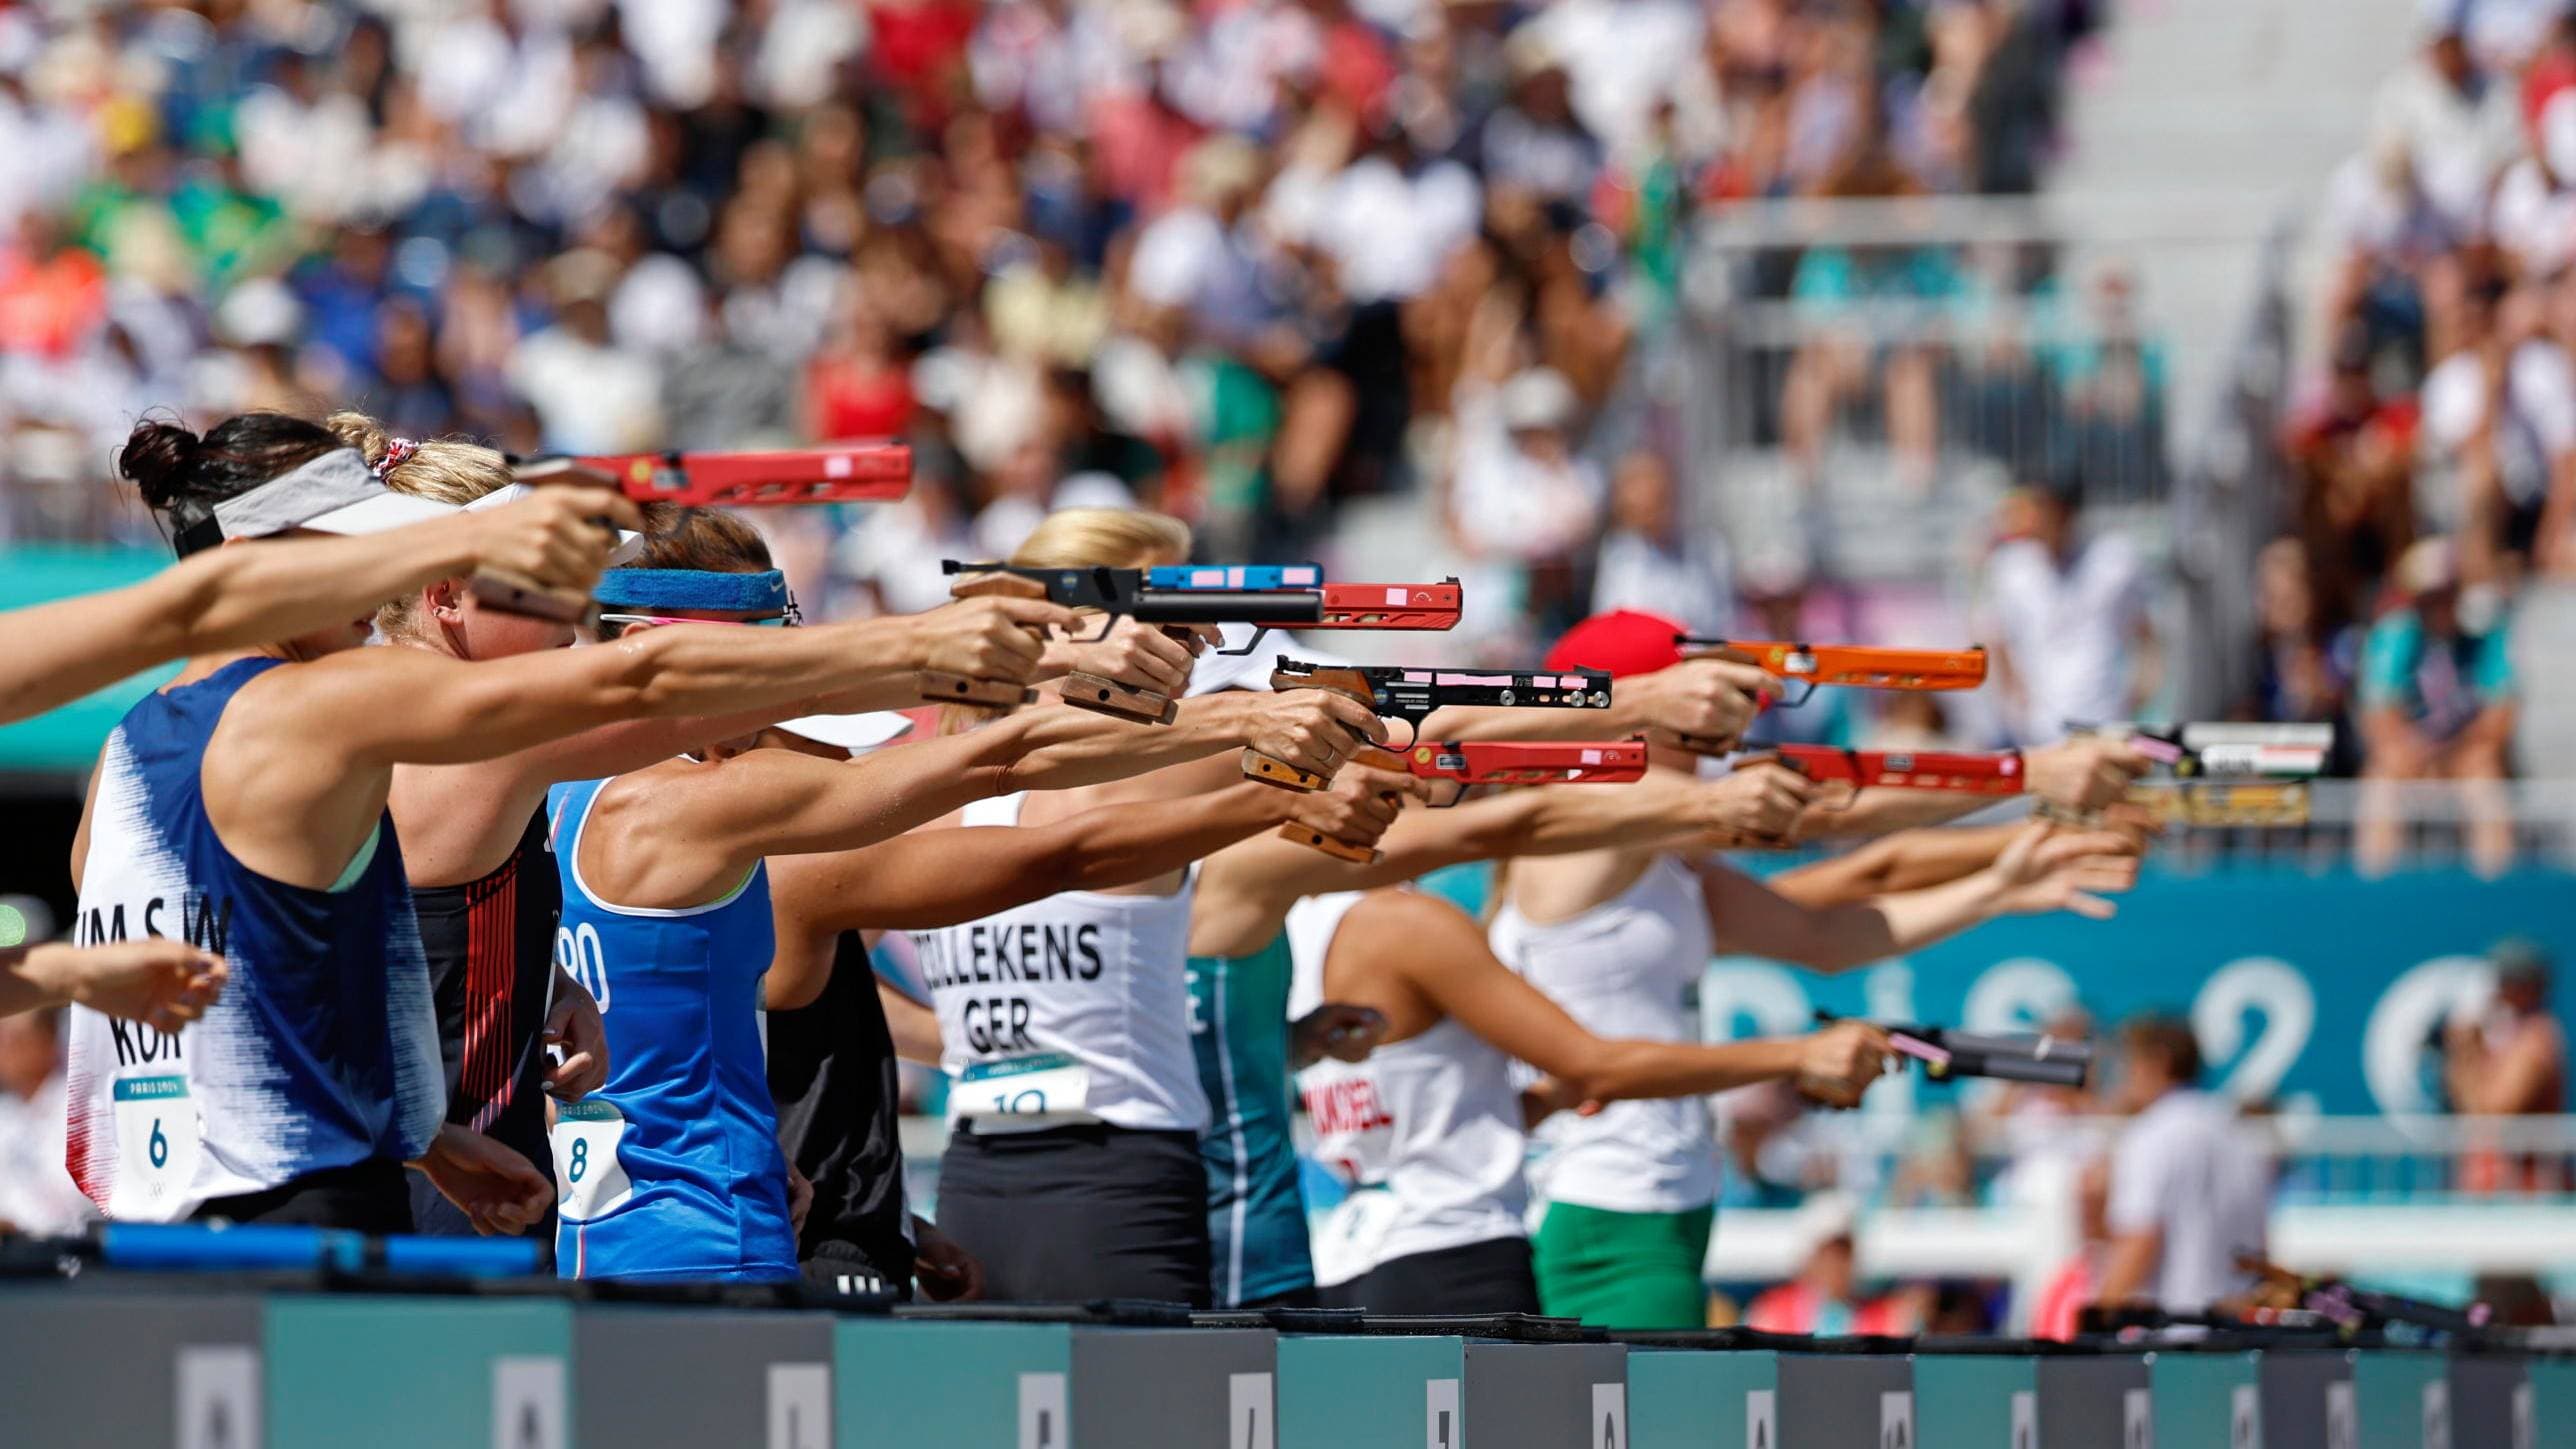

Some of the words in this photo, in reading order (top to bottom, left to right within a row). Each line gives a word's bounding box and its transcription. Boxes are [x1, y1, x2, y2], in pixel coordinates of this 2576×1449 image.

[77, 903, 127, 949] IM
[965, 997, 1037, 1054] GER
[149, 1118, 168, 1169] 6
[569, 1137, 588, 1183] 8
